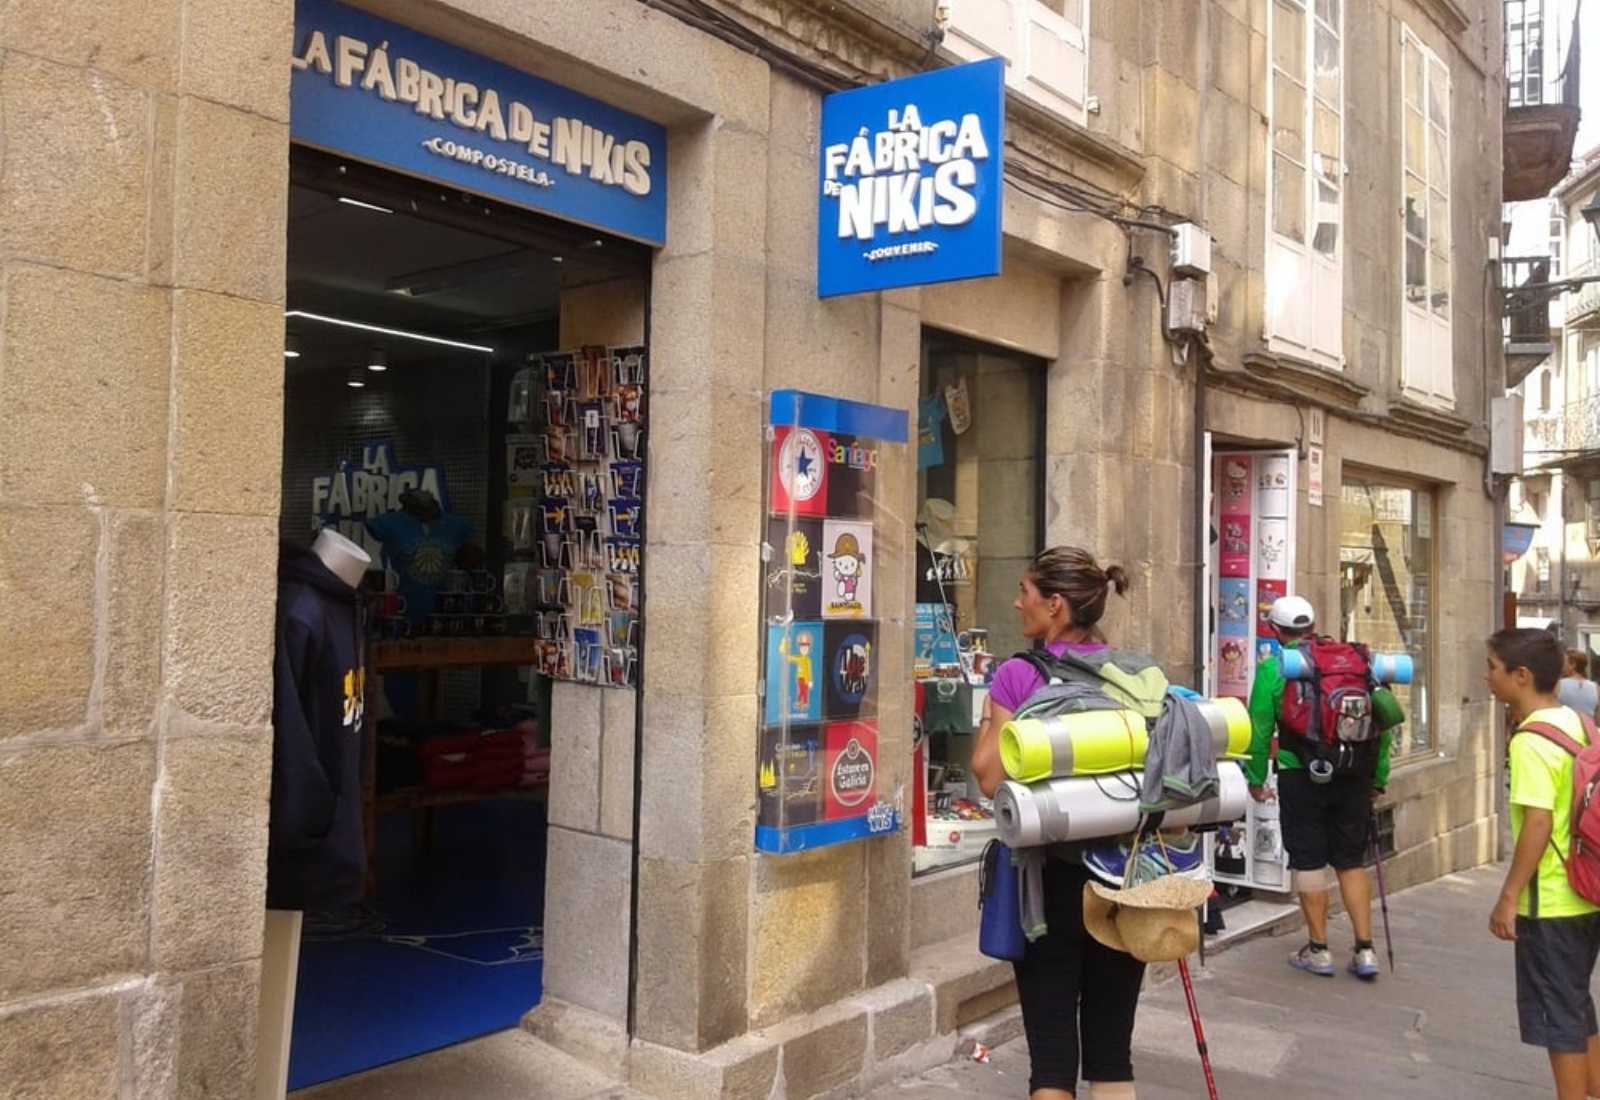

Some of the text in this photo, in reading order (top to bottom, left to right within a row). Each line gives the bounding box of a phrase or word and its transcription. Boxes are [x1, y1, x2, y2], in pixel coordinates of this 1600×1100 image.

[334, 36, 507, 141] FÁBRICA
[508, 101, 551, 158] DE
[551, 116, 651, 196] NIKIS
[888, 103, 922, 132] LA
[825, 113, 989, 178] FÁBRICA
[824, 179, 843, 197] DE
[838, 159, 977, 240] NIKIS
[363, 445, 389, 475] LA
[827, 438, 879, 472] Santiago
